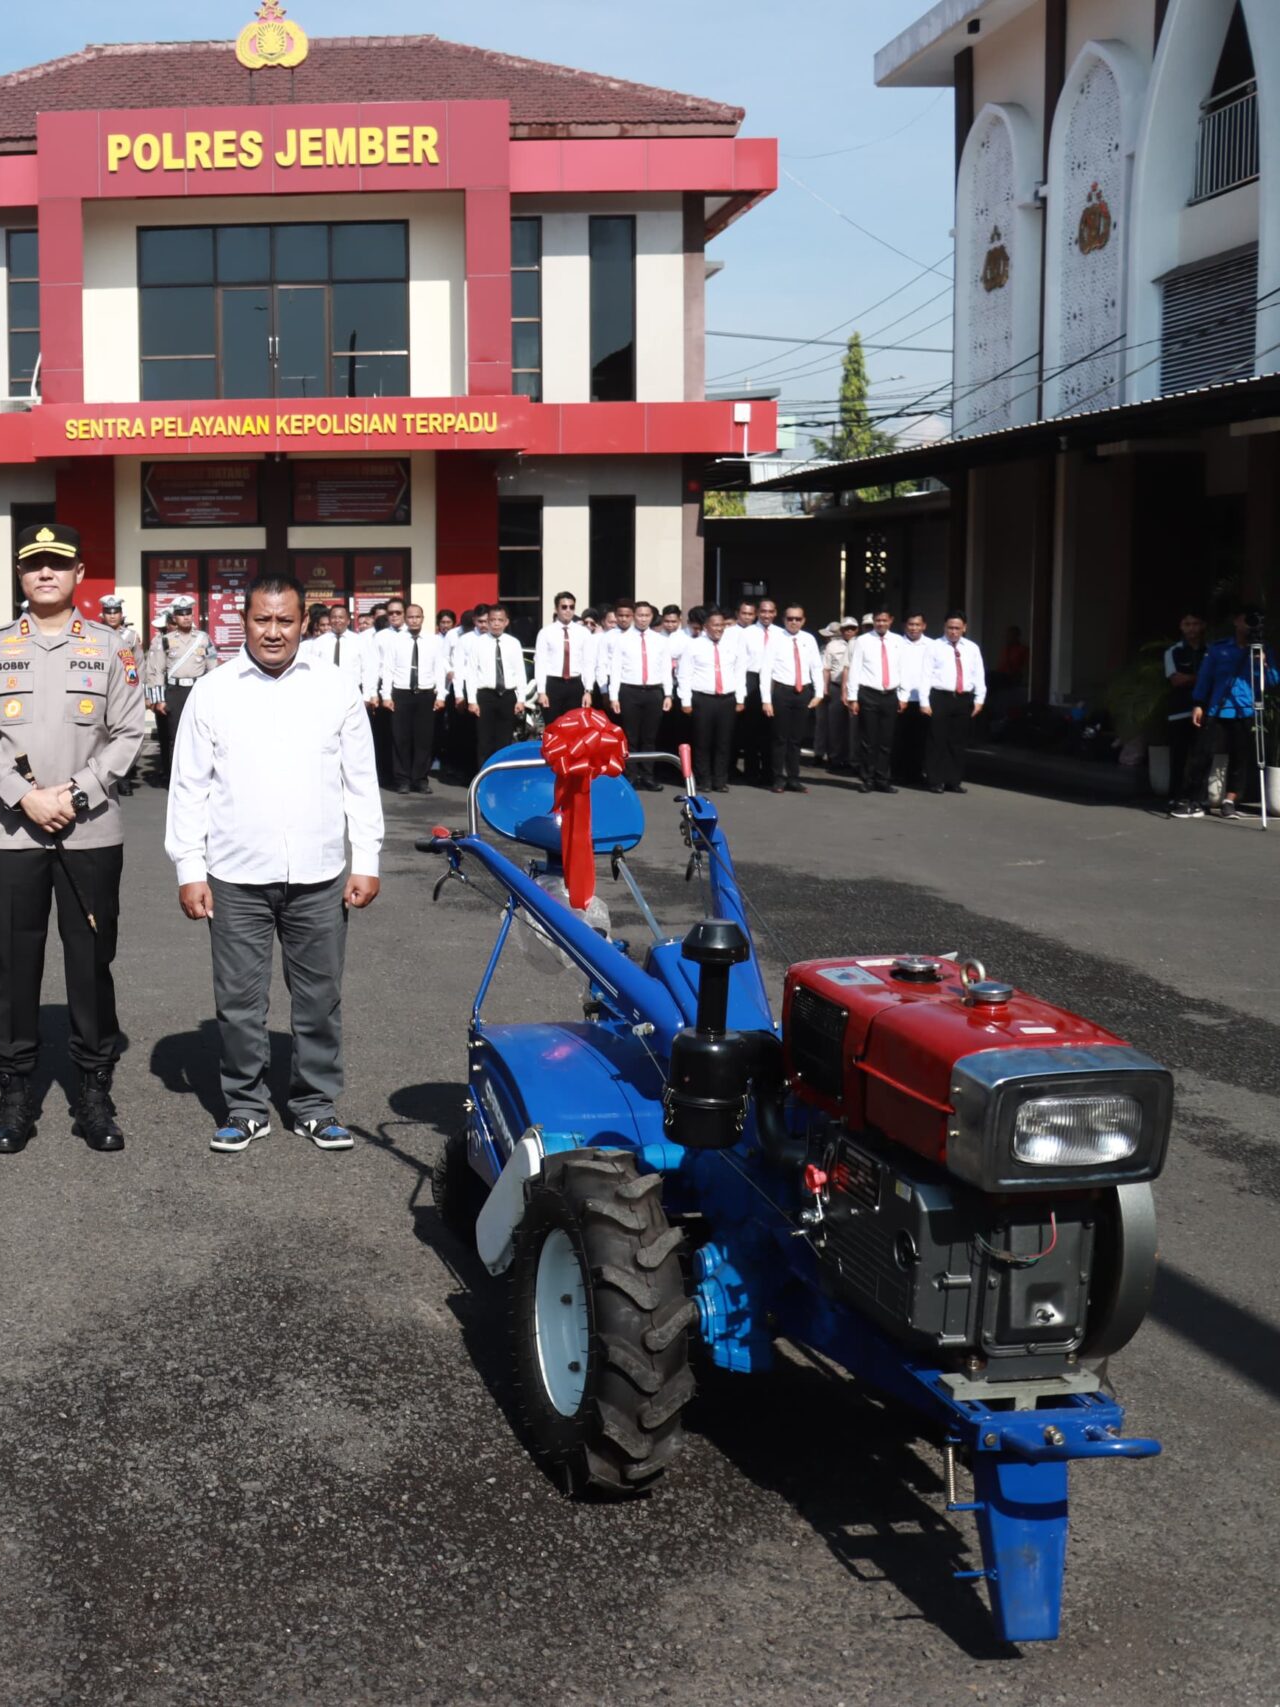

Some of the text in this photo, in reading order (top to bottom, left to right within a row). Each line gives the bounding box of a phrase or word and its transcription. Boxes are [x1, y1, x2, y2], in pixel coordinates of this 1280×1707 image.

[107, 126, 440, 172] POLRES JEMBER
[65, 411, 498, 440] SENTRA PELAYANAN KEPOLISIAN TERPADU
[70, 660, 105, 671] POLRI
